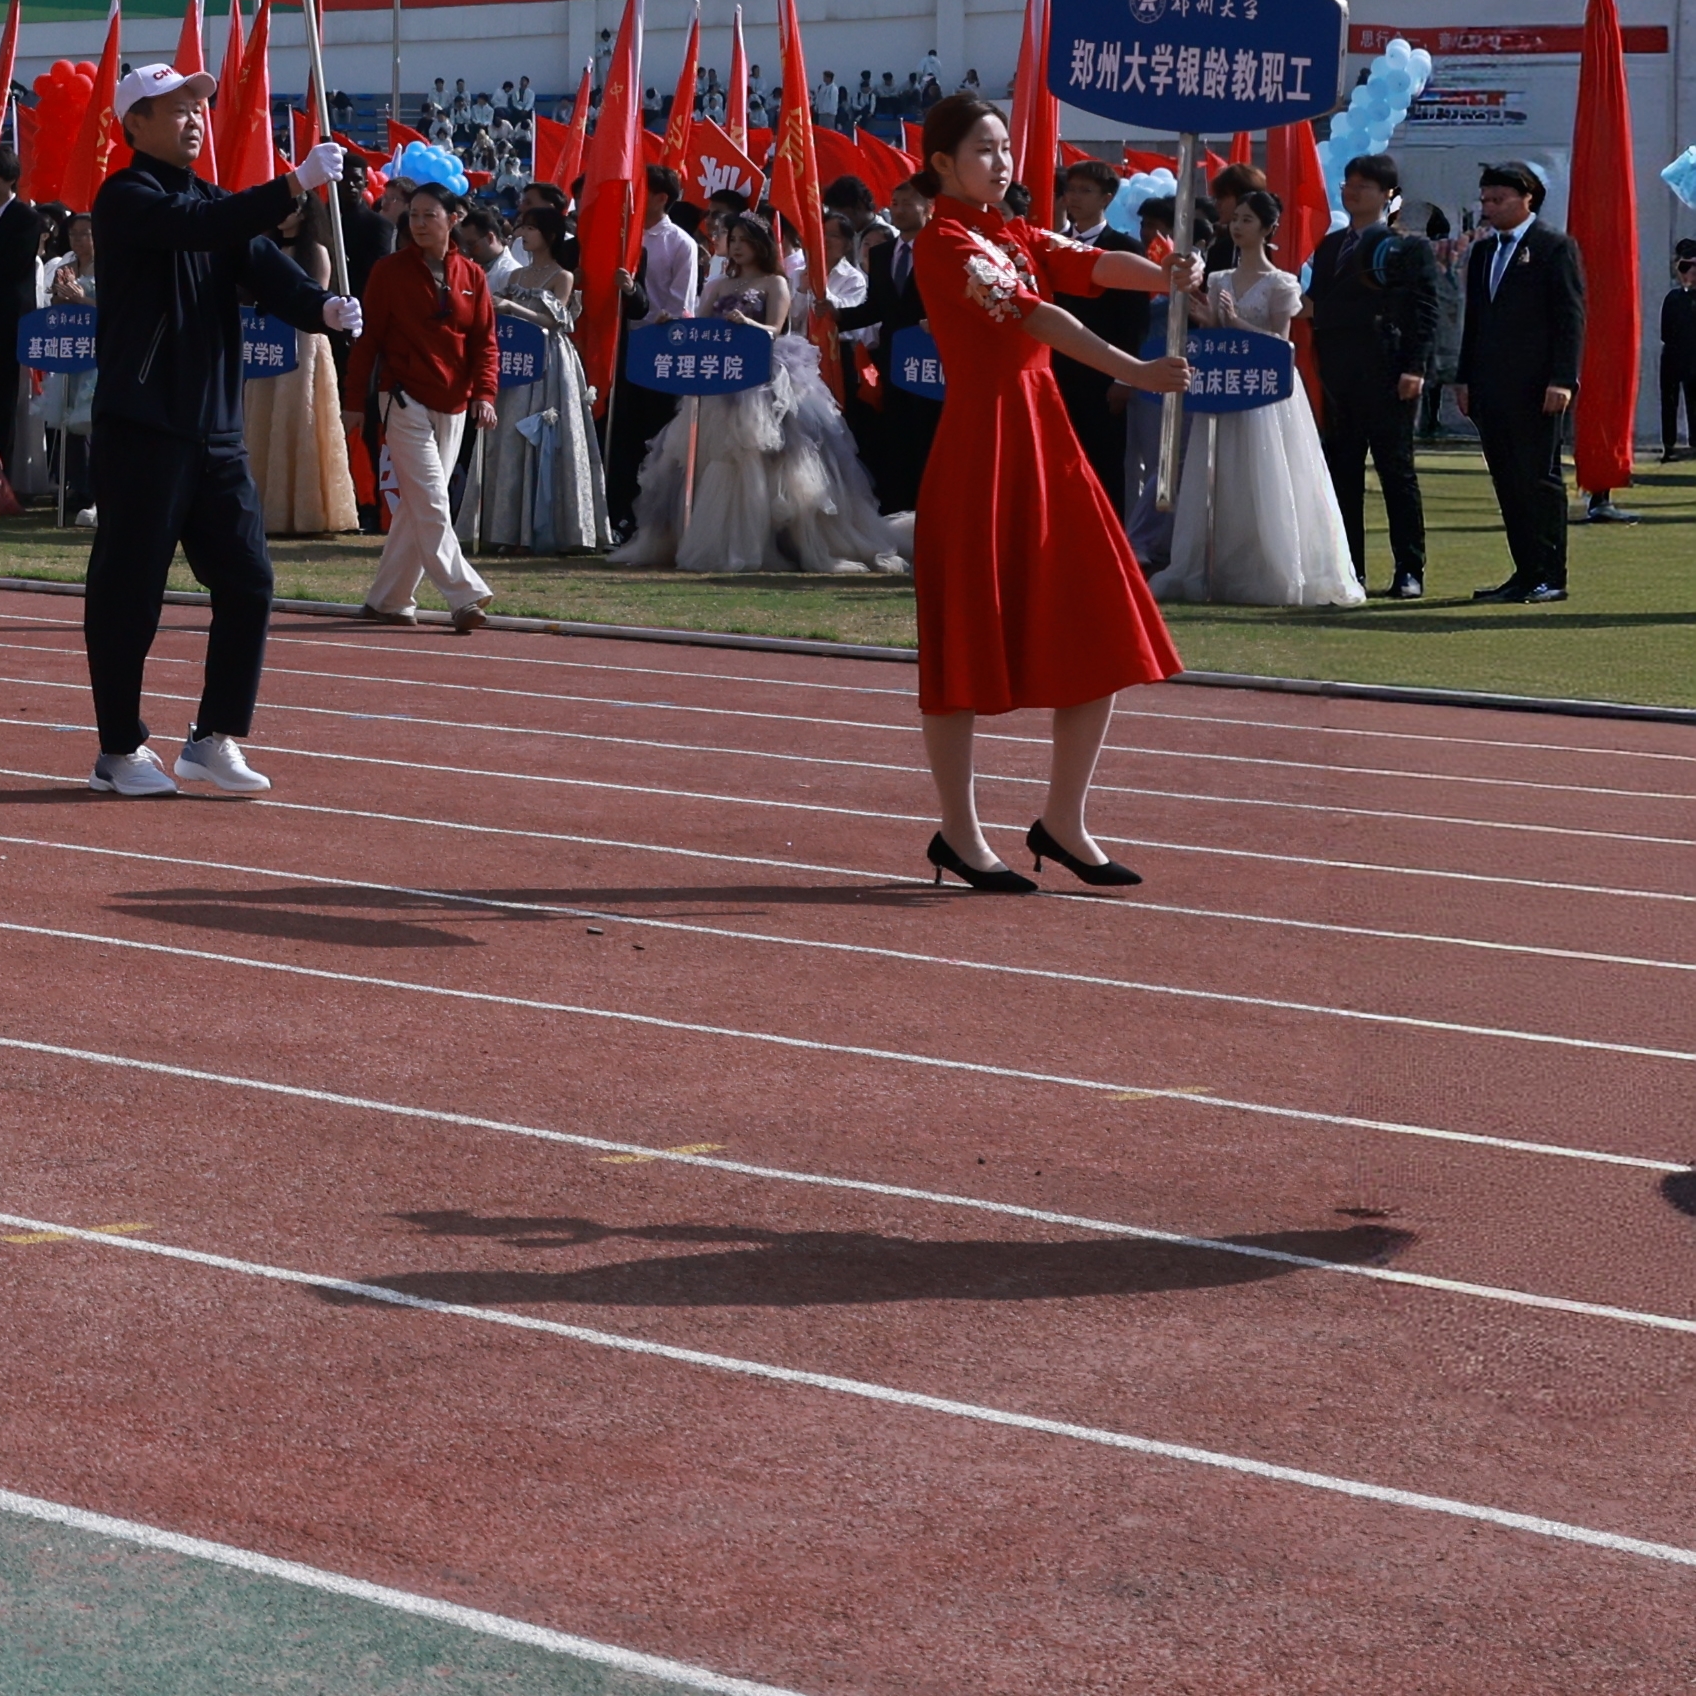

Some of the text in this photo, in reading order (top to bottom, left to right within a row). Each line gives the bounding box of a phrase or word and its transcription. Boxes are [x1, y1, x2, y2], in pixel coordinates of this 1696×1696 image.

[1068, 38, 1313, 104] 郑州大学银龄教职工
[60, 312, 92, 327] 郑州大学
[689, 327, 733, 343] 郑州大学
[1204, 339, 1250, 355] 郑州大学
[653, 354, 744, 380] 管理学院
